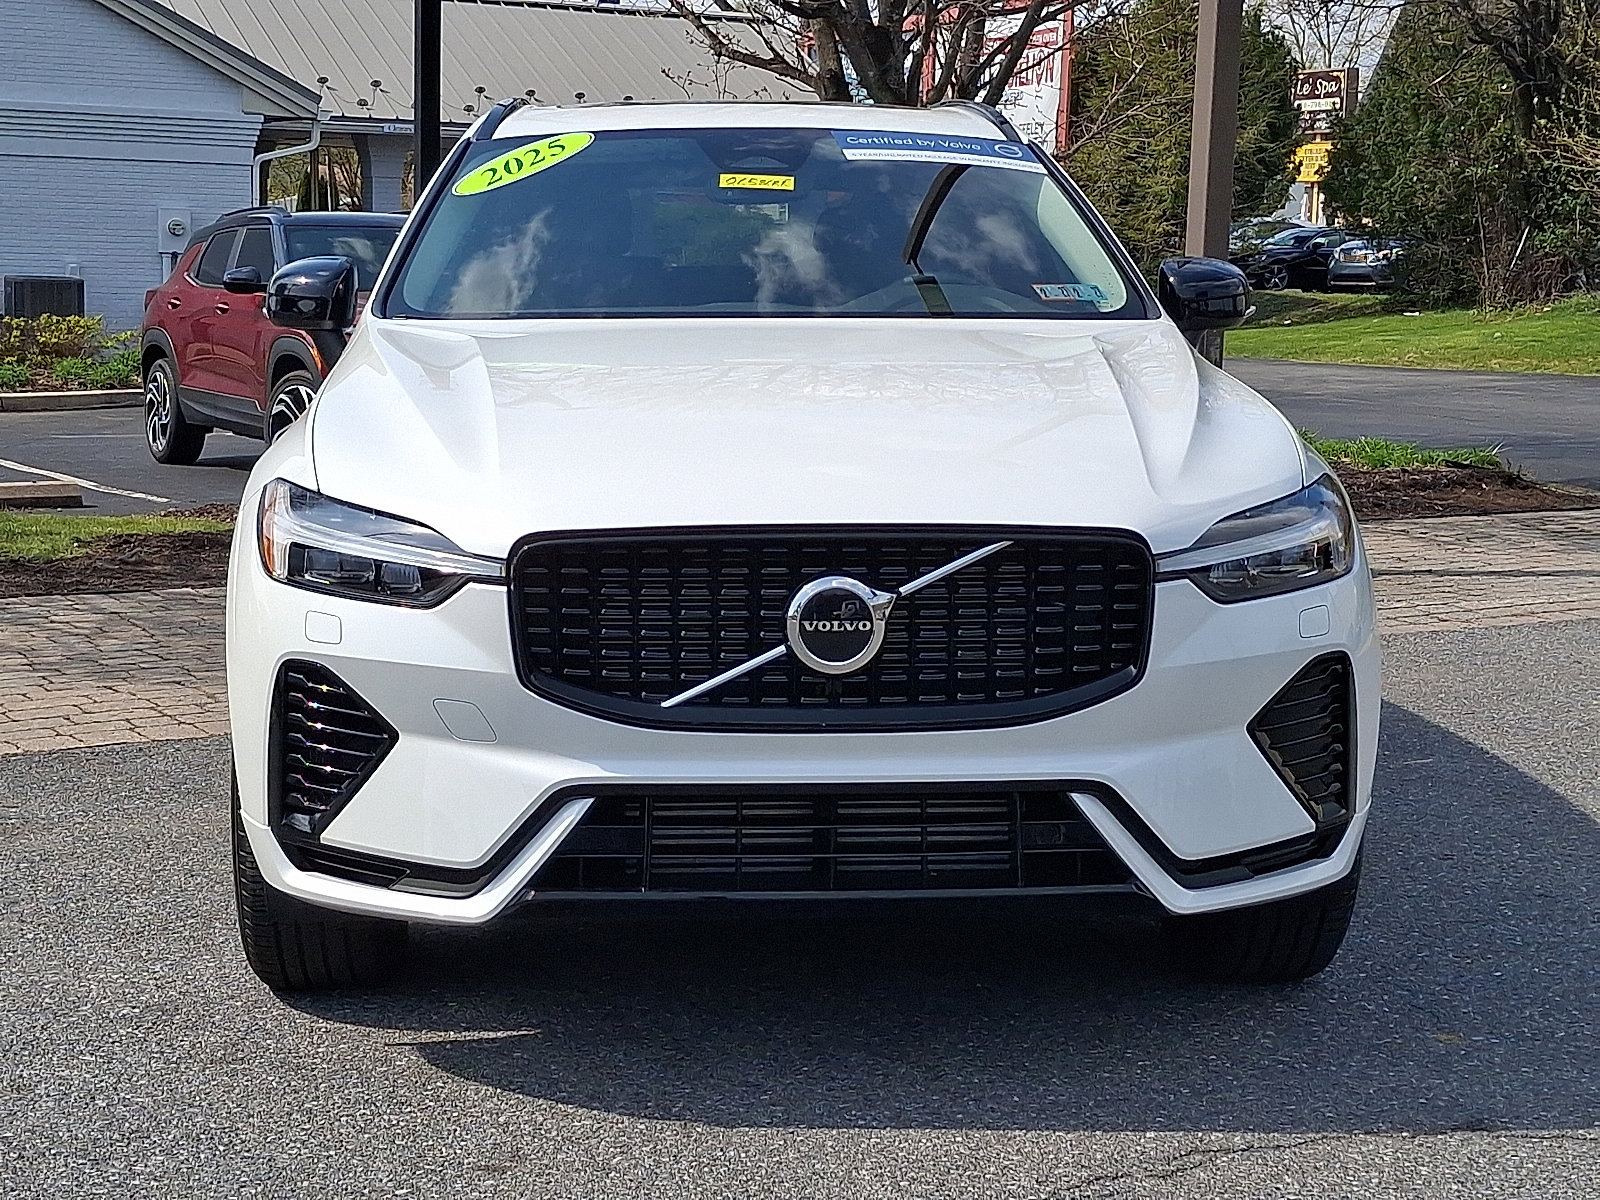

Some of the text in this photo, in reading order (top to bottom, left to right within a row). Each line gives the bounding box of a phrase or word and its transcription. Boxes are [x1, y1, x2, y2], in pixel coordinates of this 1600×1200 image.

[1314, 79, 1340, 98] Spa
[846, 136, 981, 151] Certified by Volvo
[481, 138, 566, 187] 2025
[801, 620, 872, 632] VOLVO
